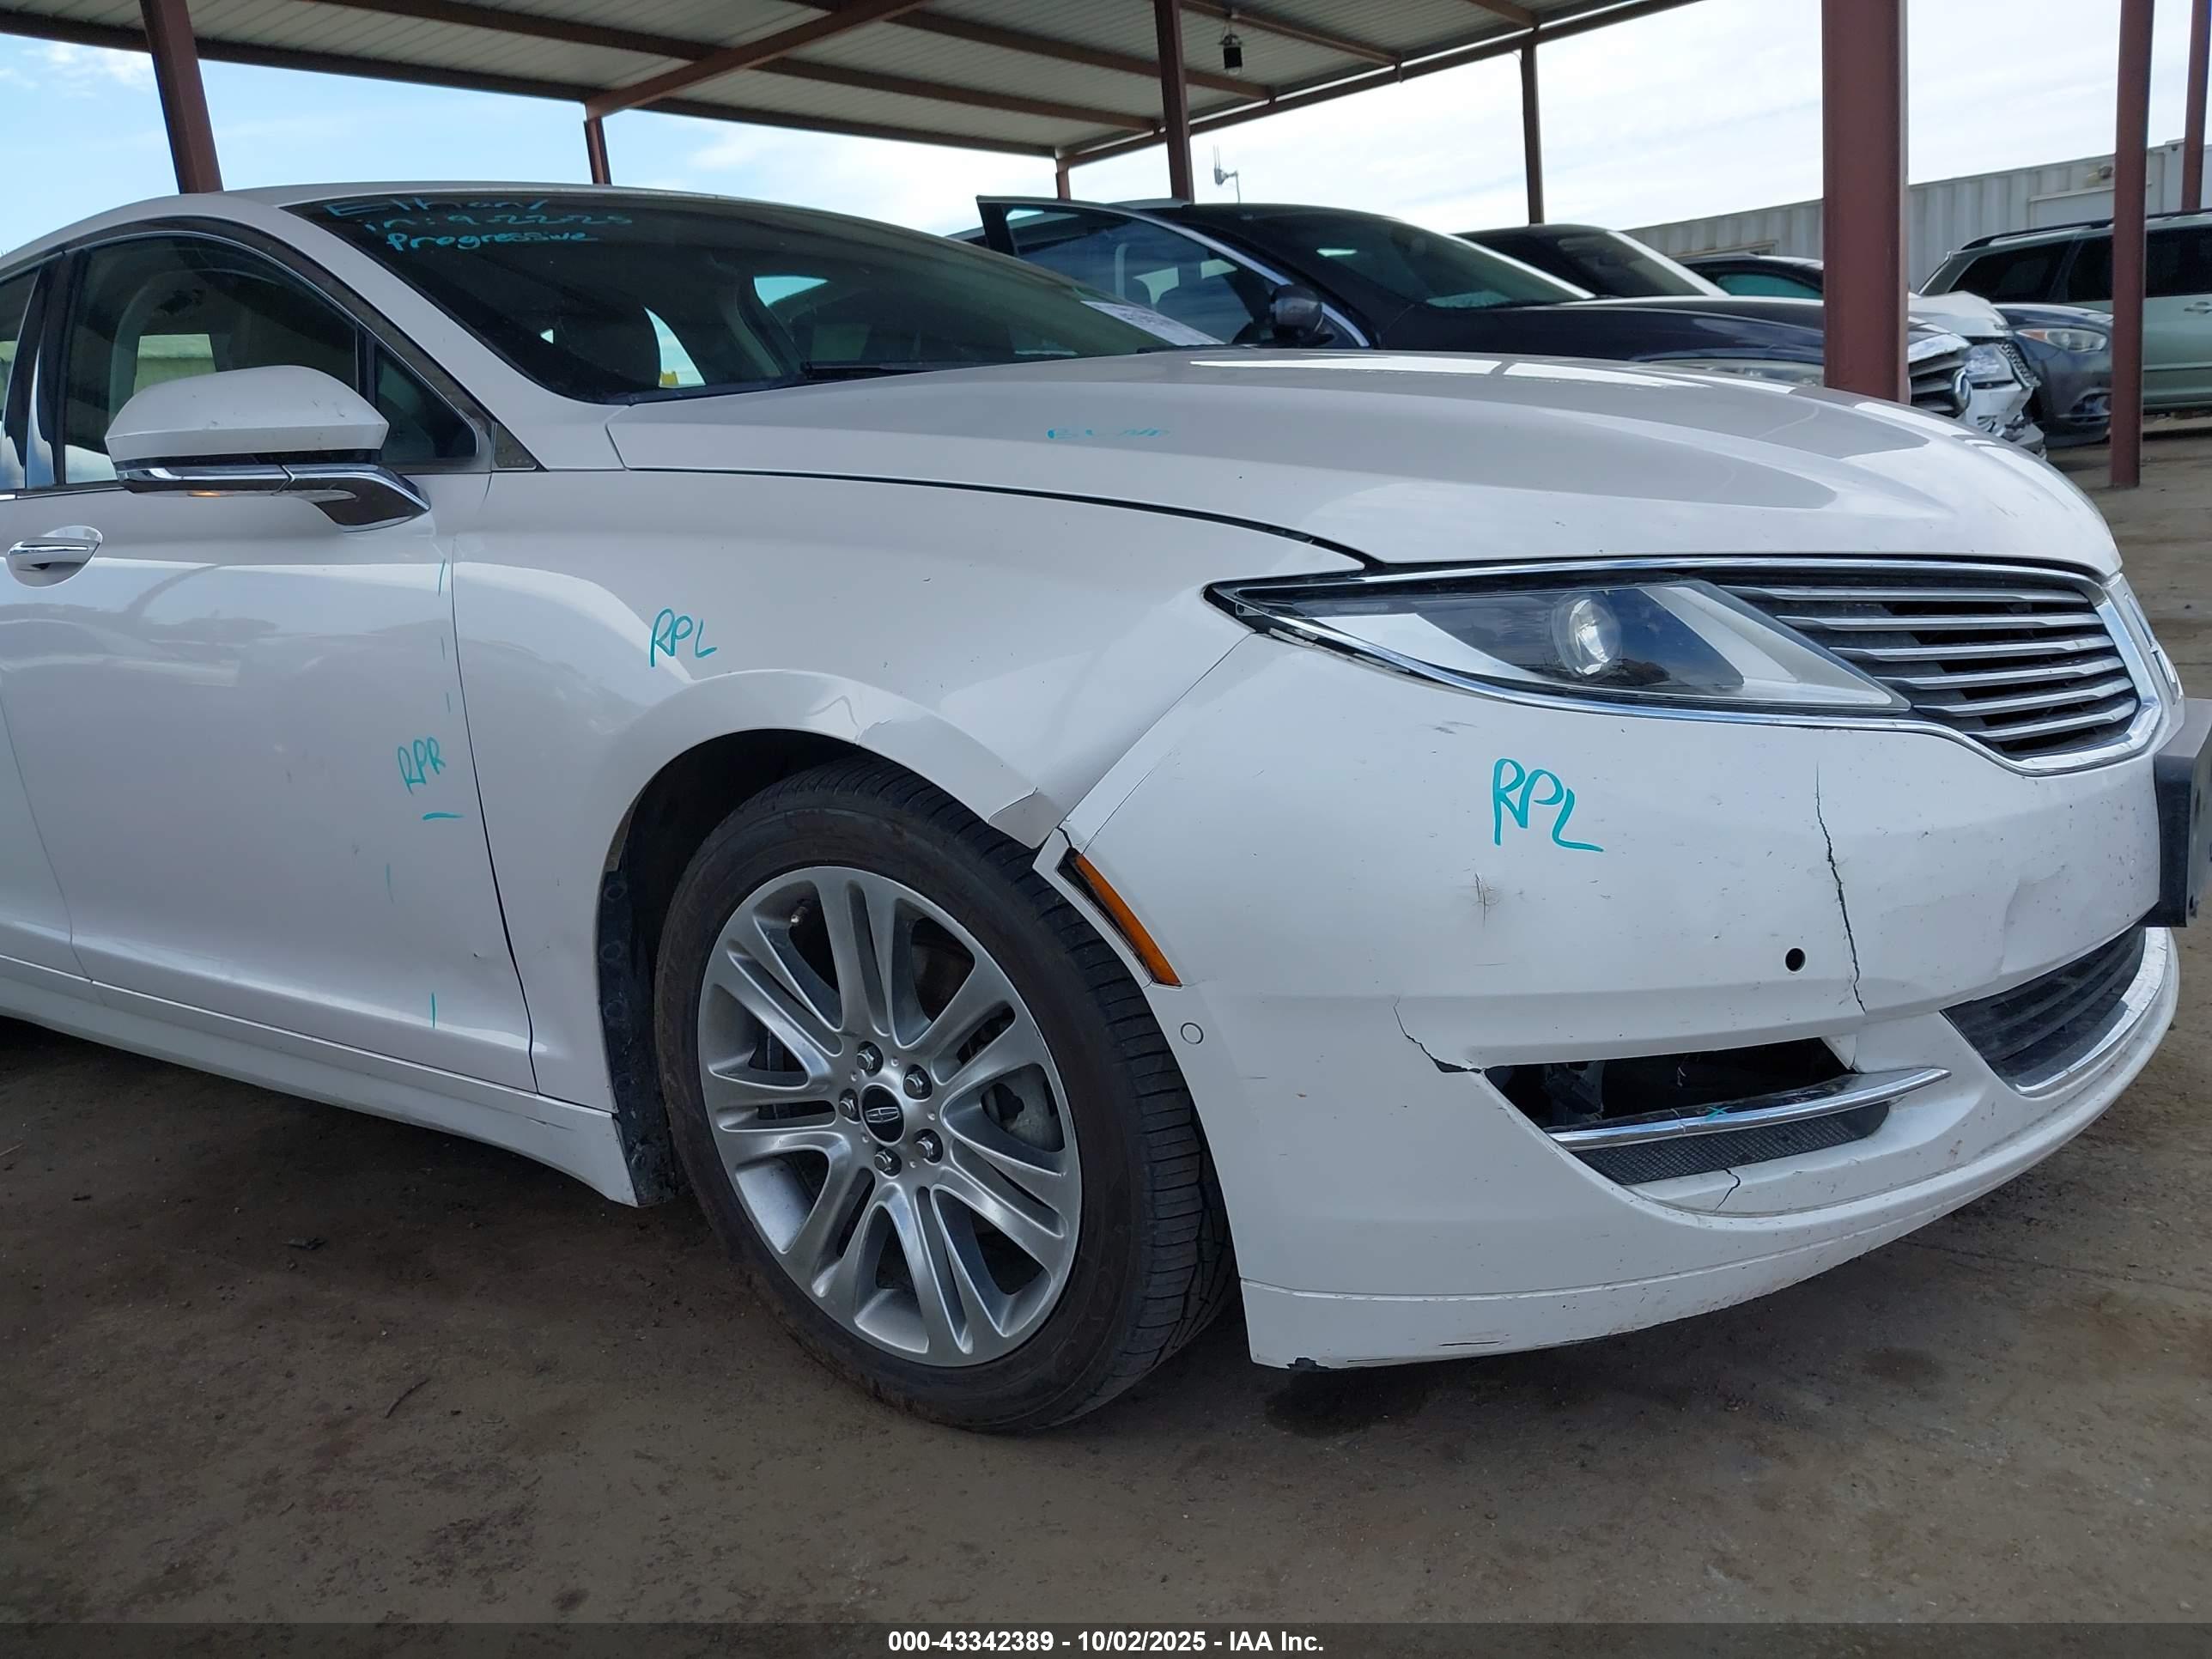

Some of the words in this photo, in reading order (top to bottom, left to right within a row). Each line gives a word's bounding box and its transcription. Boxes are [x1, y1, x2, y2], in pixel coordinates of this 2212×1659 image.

[649, 608, 718, 667] RPL
[397, 736, 447, 794] RPR
[1492, 757, 1604, 853] RPL
